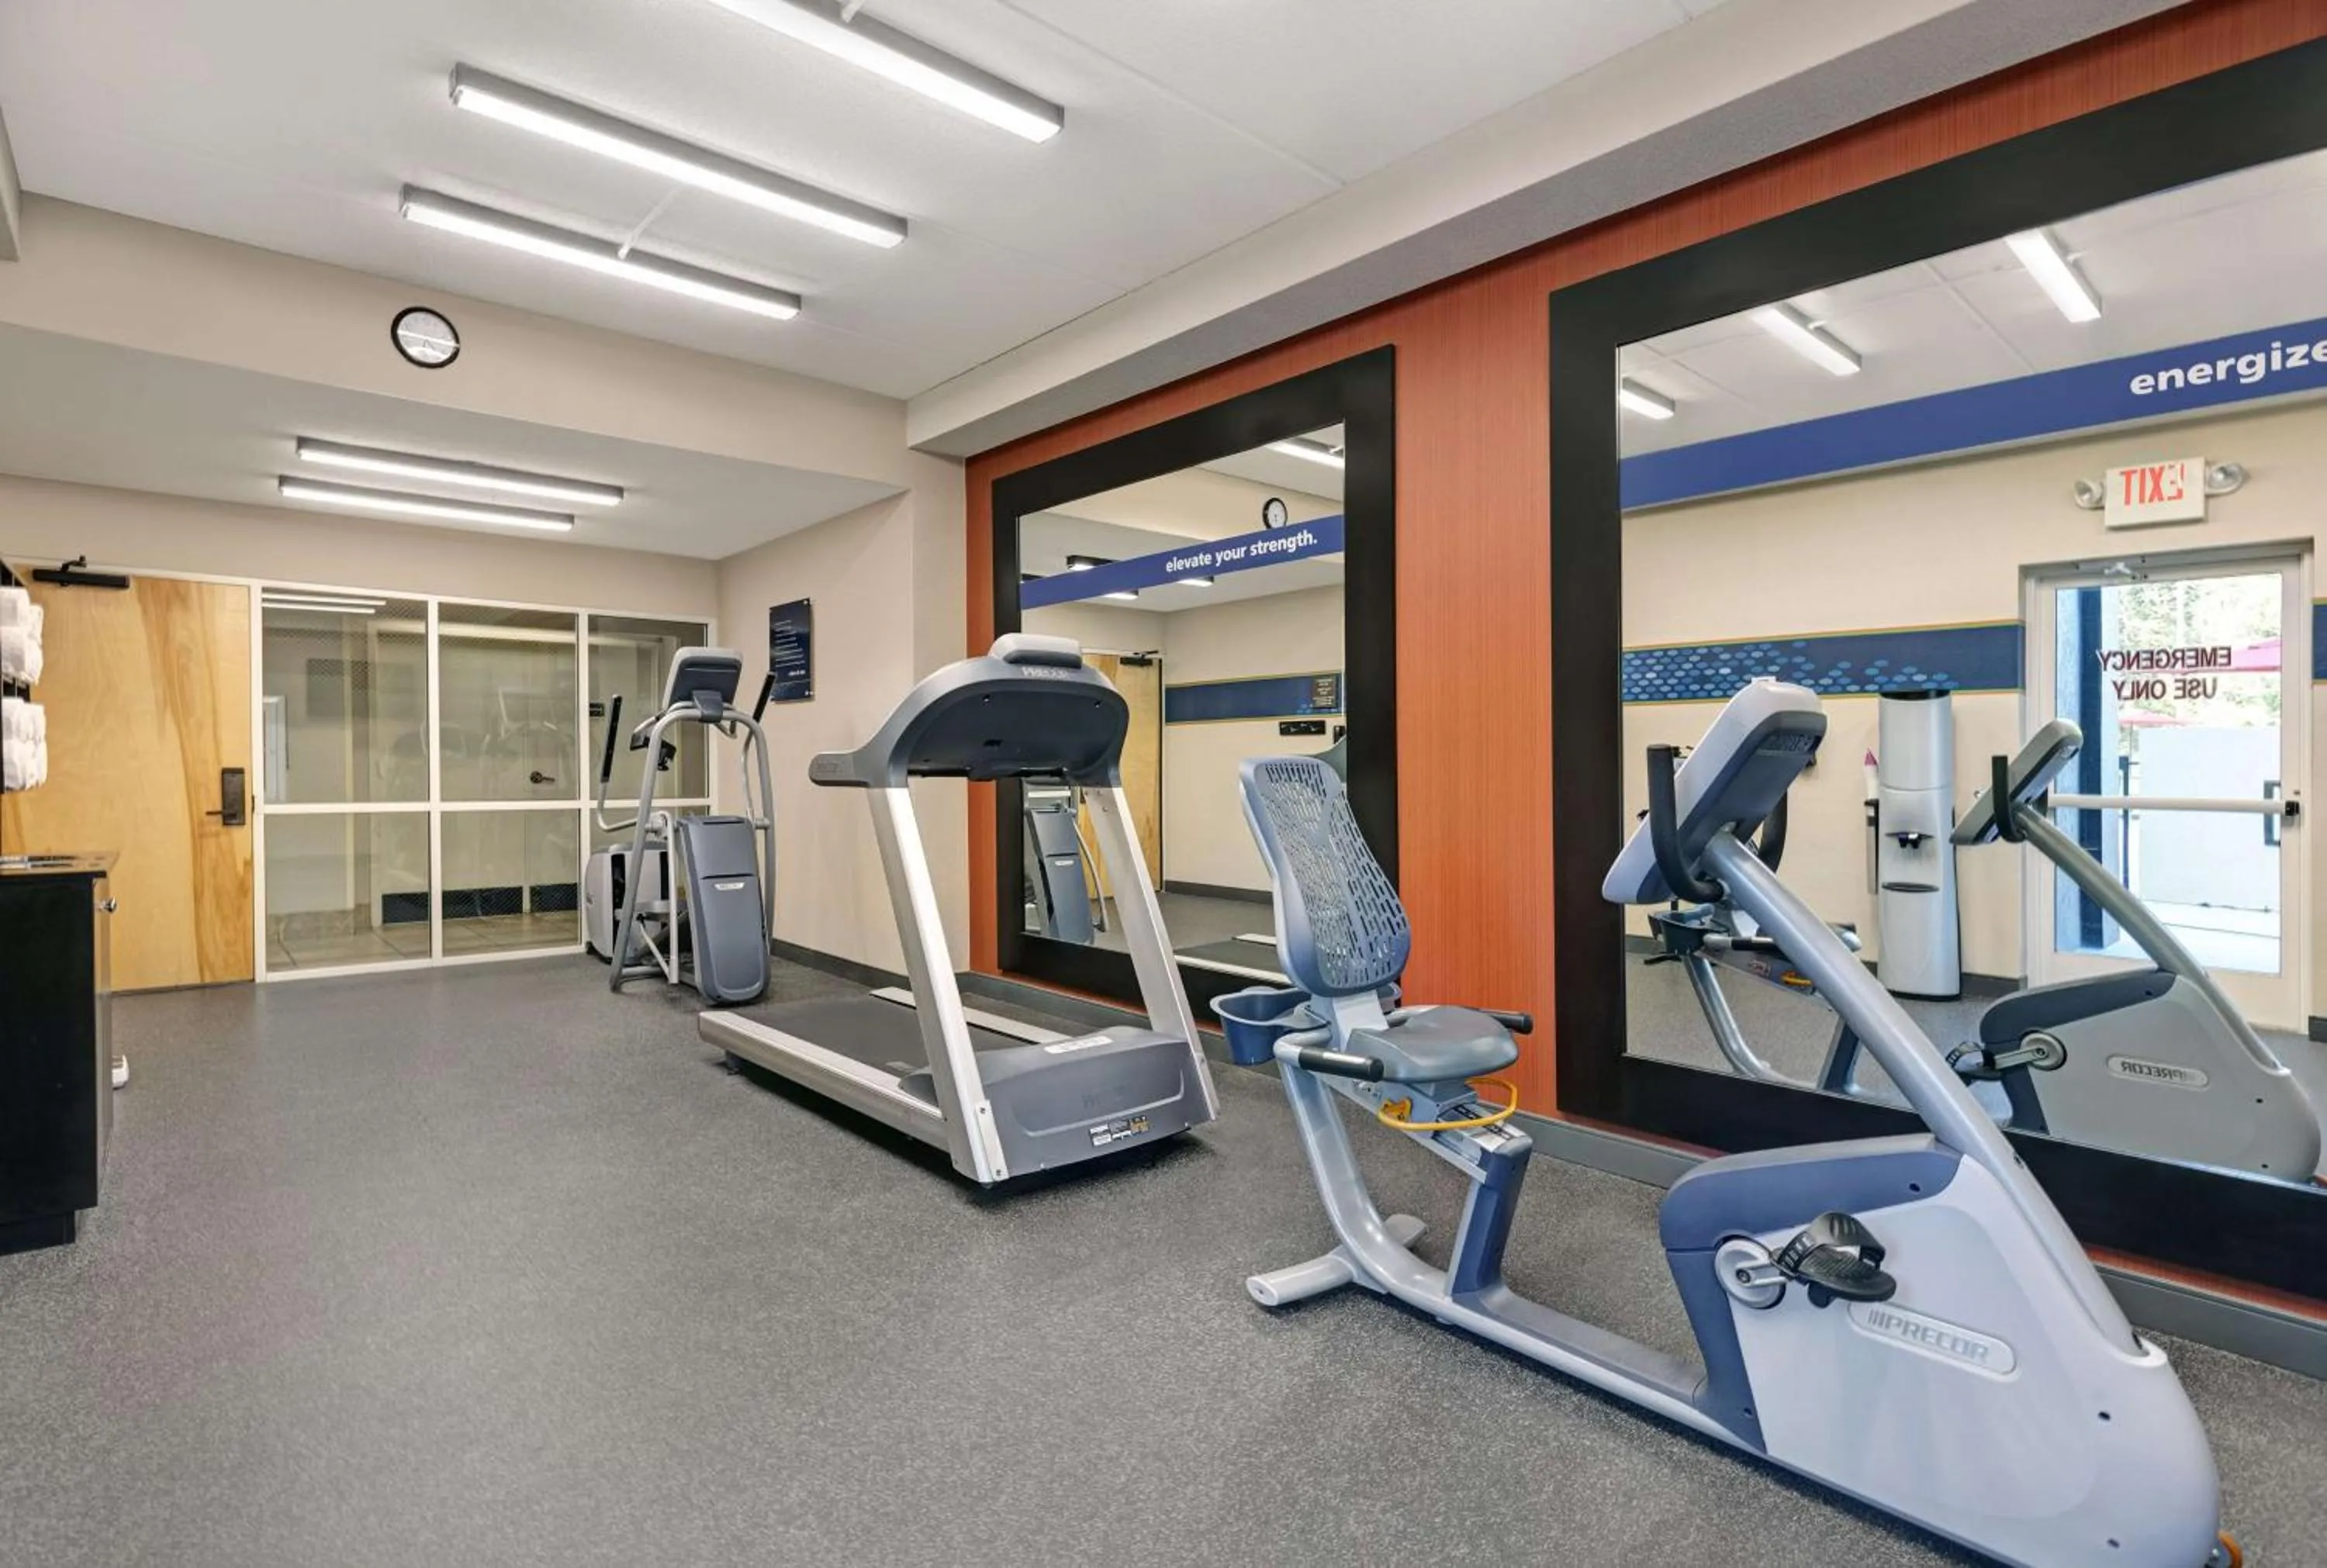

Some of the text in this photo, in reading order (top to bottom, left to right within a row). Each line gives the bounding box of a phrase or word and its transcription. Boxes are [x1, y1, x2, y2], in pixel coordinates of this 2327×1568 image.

[1165, 529, 1318, 572] elevate your strength.
